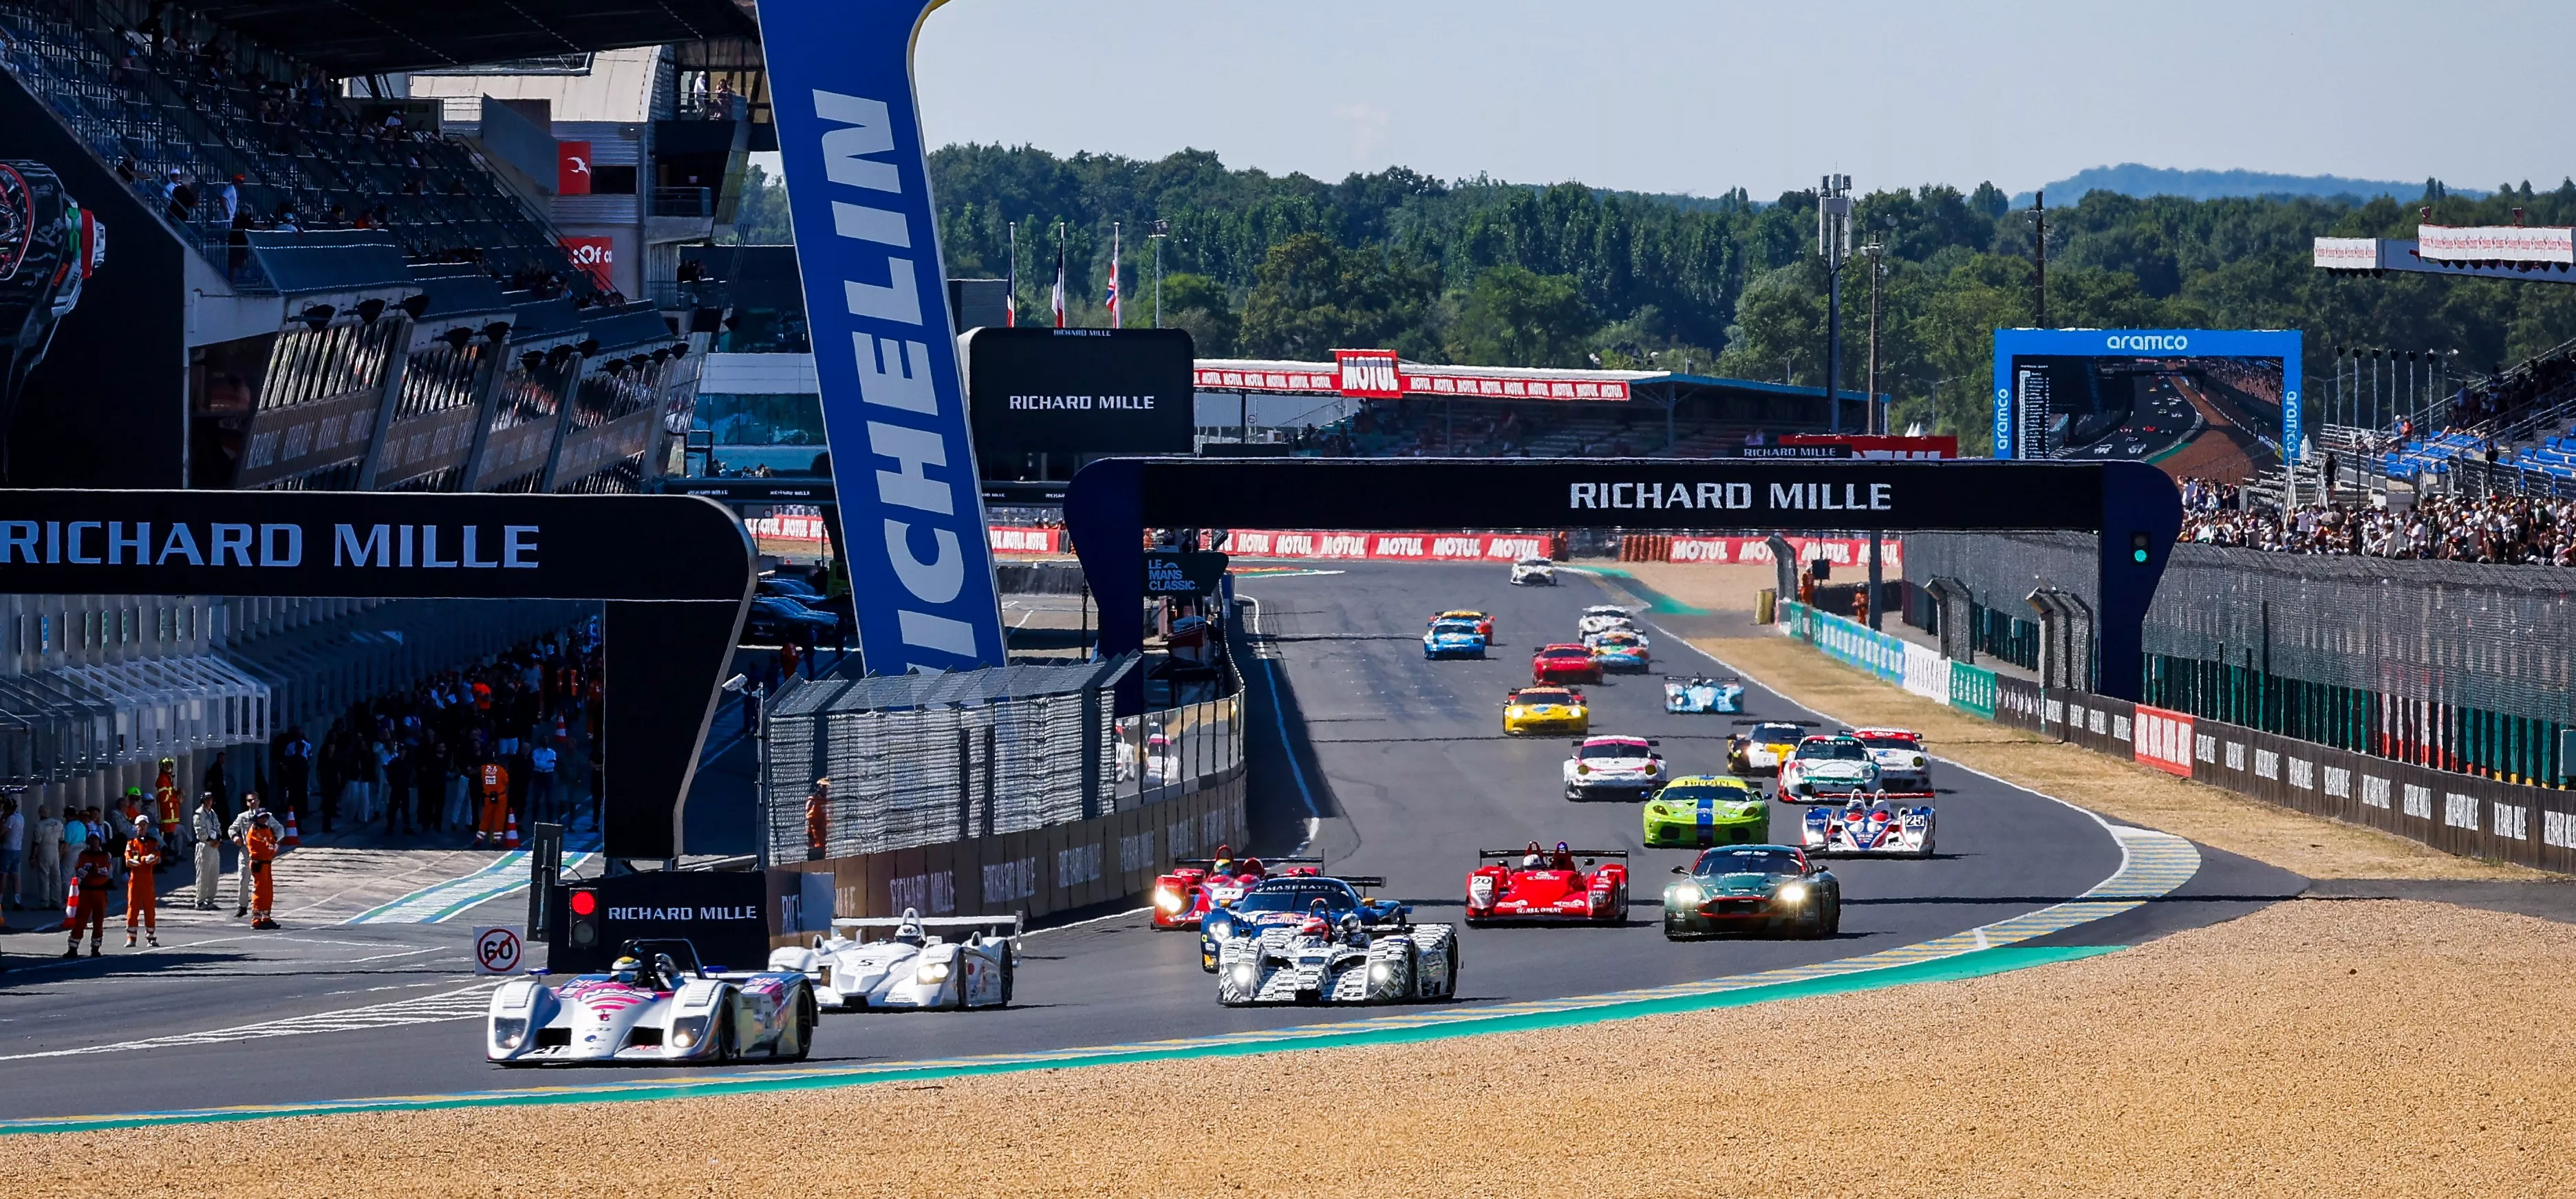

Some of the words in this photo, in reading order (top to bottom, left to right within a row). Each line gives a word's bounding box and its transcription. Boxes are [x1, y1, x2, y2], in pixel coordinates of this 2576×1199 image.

[2107, 335, 2188, 351] aramco
[813, 89, 977, 675] ICHELIN
[1342, 356, 1399, 391] MOTUL
[1009, 395, 1092, 410] RICHARD
[1099, 395, 1155, 410] MILLE
[1997, 388, 2009, 450] aramco
[2286, 390, 2298, 453] aramco
[1743, 448, 1796, 457] RICHARD
[1801, 447, 1836, 457] MILLE
[1570, 482, 1752, 509] RICHARD
[1770, 483, 1892, 510] MILLE
[0, 520, 302, 566] RICHARD
[334, 524, 540, 568] MILLE
[1237, 533, 1269, 553] MOTUL
[1275, 534, 1313, 555] MOTUL
[1320, 535, 1366, 556] MOTUL
[1375, 537, 1424, 555] MOTUL
[1432, 538, 1481, 558] MOTUL
[1487, 538, 1541, 559] MOTUL
[1672, 540, 1728, 560] MOTUL
[1148, 560, 1162, 569] LE
[1148, 570, 1183, 580] MANS
[1148, 580, 1196, 591] CLASSIC
[1907, 816, 1924, 826] 25
[608, 906, 693, 921] RICHARD
[700, 905, 757, 920] MILLE
[483, 939, 513, 961] 60
[533, 1046, 562, 1054] 21
